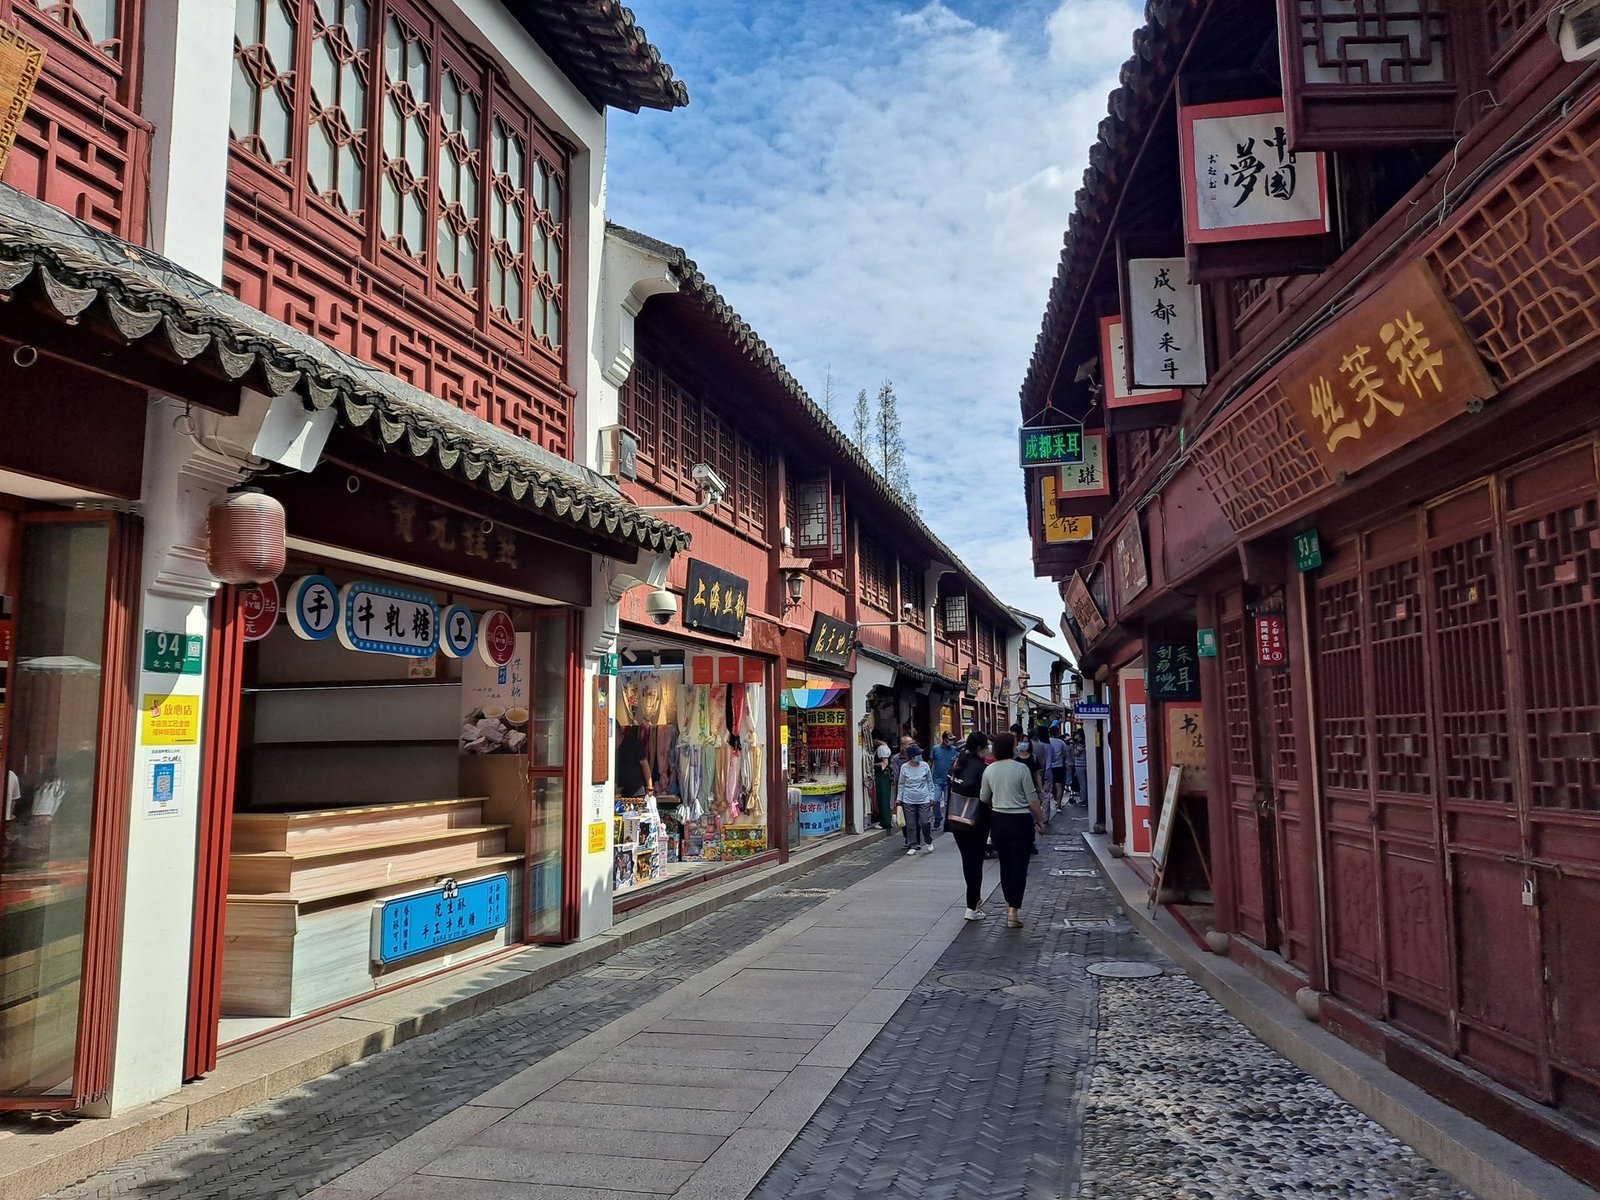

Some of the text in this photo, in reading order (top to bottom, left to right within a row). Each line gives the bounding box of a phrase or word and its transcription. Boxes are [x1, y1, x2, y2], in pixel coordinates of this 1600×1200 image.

[1224, 137, 1264, 208] 夢
[1150, 268, 1181, 380] 成都采耳
[1309, 309, 1443, 452] 丝芙祥
[1025, 432, 1080, 459] 成都采耳
[1078, 465, 1100, 486] 罐
[1298, 537, 1309, 557] 93
[306, 589, 329, 627] 手
[454, 617, 467, 642] 工
[157, 633, 180, 656] 94
[152, 659, 181, 670] 北大街
[1176, 646, 1193, 692] 采耳
[164, 704, 193, 716] 放心店
[807, 711, 846, 724] 箱包寄存
